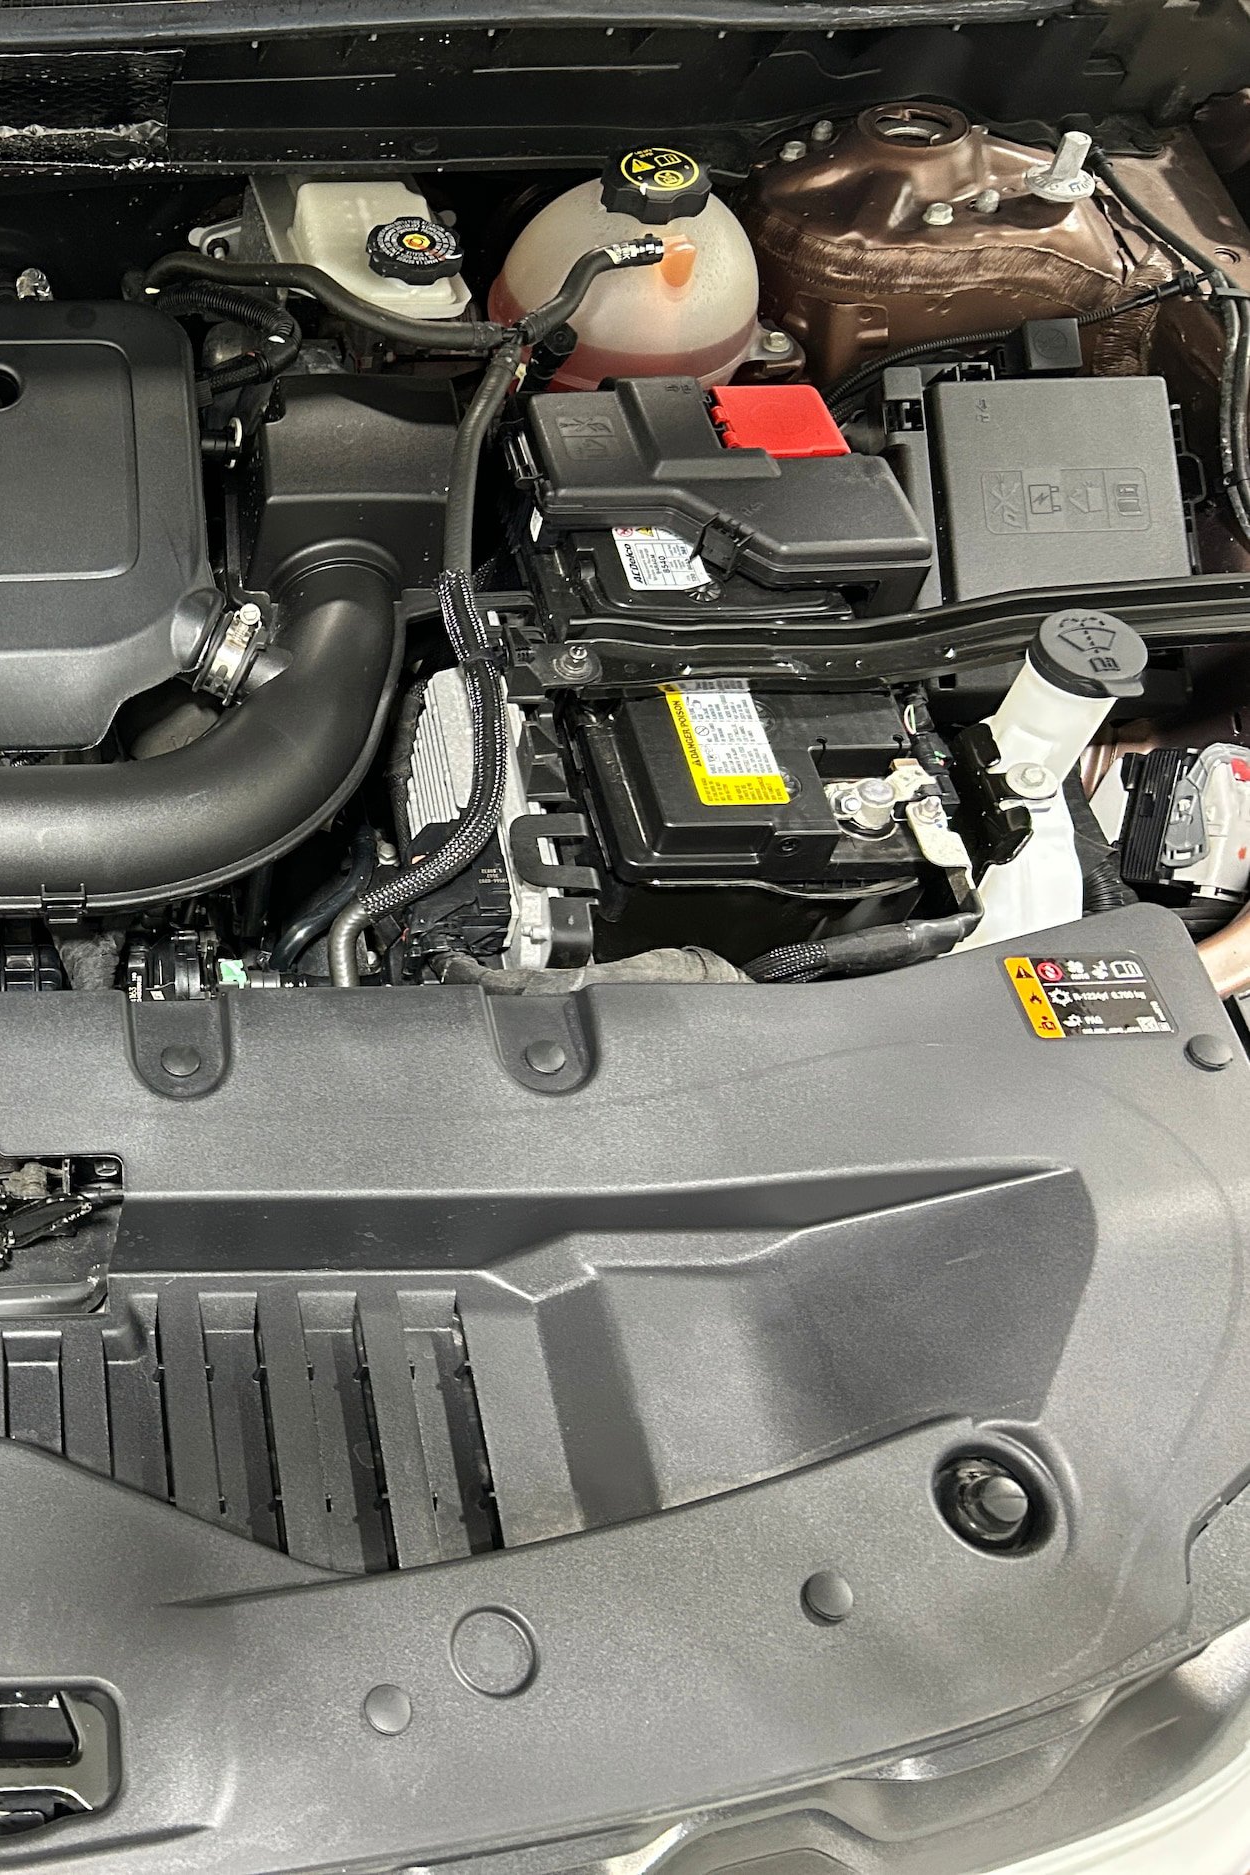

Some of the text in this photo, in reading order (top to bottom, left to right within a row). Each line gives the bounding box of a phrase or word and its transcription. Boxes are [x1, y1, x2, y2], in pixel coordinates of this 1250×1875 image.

[623, 543, 644, 584] ACDelco
[672, 700, 700, 760] DANGER POISON
